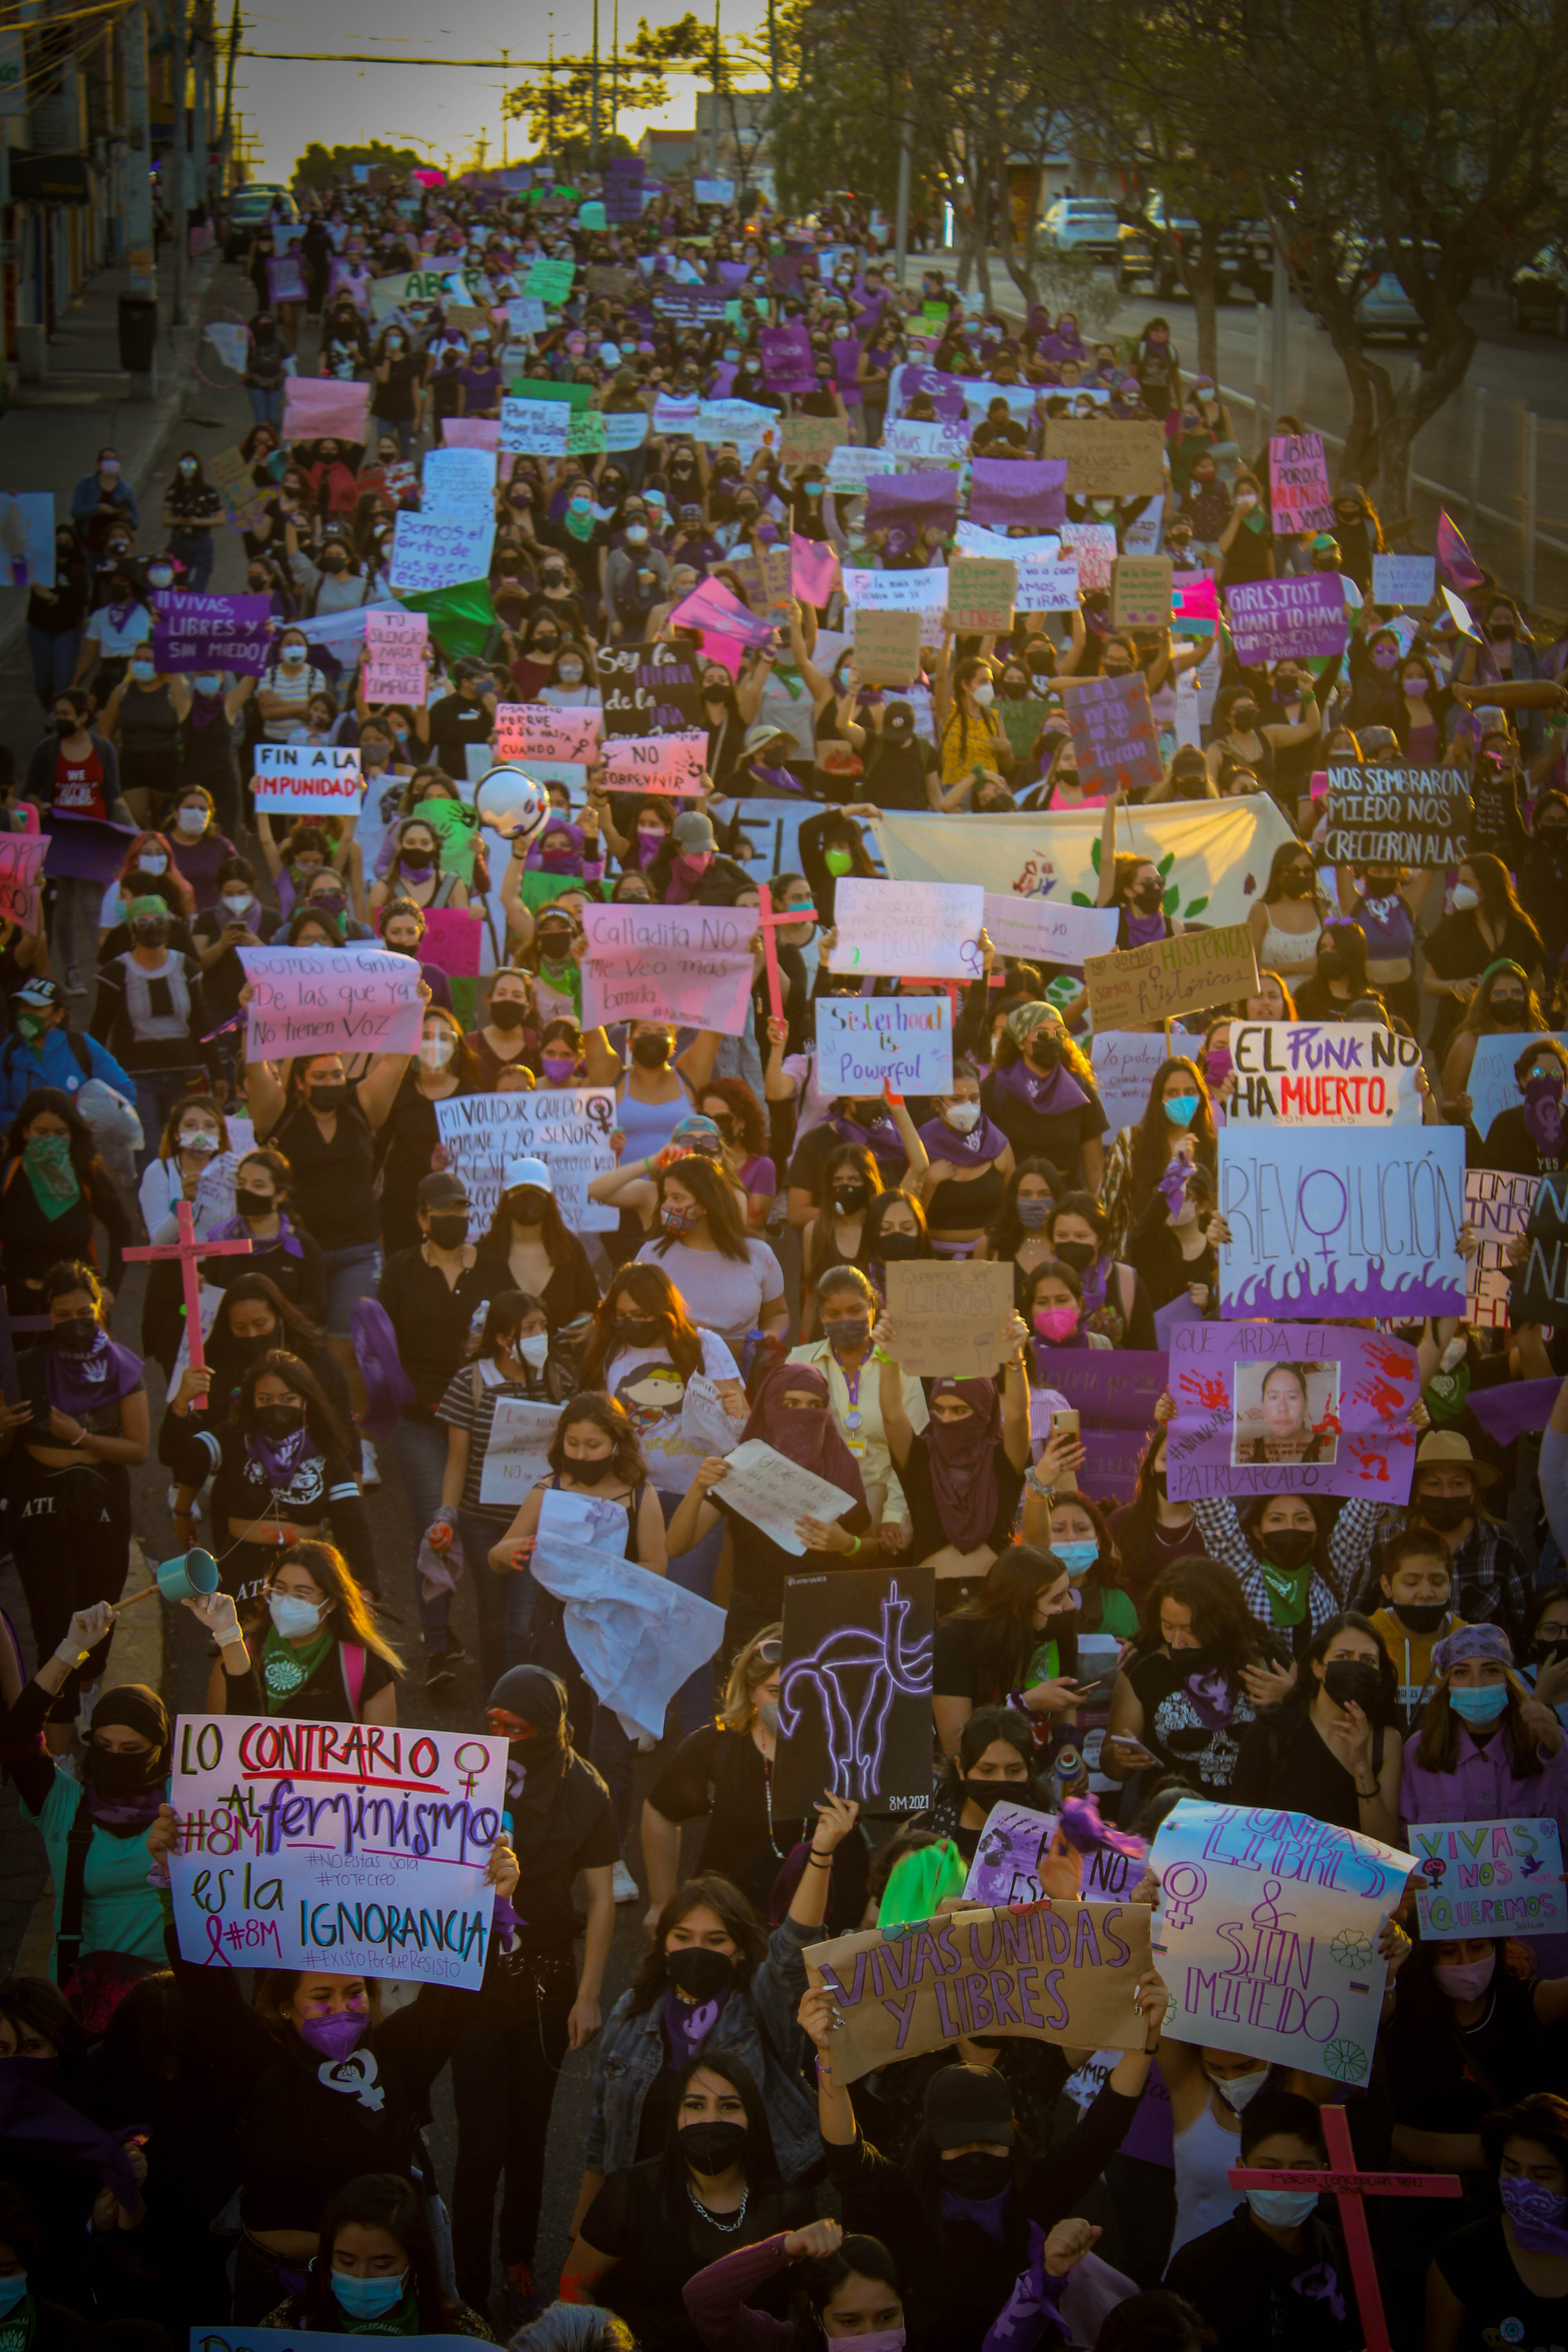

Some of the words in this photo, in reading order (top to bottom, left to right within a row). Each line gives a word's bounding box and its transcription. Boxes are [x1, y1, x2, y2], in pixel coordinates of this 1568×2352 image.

[1018, 582, 1057, 592] AMOS
[1229, 584, 1275, 612] GIRLS
[1277, 582, 1321, 607] JUST
[169, 617, 235, 637] LIBRES
[1233, 611, 1279, 633] WANT
[1285, 609, 1305, 628] TO
[169, 642, 196, 659] SIN
[597, 646, 641, 674] Soy
[652, 642, 677, 666] la
[605, 688, 633, 710] de
[501, 715, 551, 728] PORQUE
[261, 748, 298, 766] FIN
[312, 749, 327, 766] A
[333, 752, 357, 768] LA
[501, 744, 555, 755] CUANDO
[632, 746, 659, 764] NO
[257, 776, 356, 797] IMPUNIDAD
[1328, 766, 1362, 790] NOS
[1364, 767, 1471, 795] SEMBRARON
[1406, 797, 1452, 827] NOS
[1324, 829, 1423, 864] CRECIERON
[1424, 835, 1468, 864] ALAS
[592, 916, 690, 949] Calladita
[700, 917, 739, 951] NO
[332, 955, 352, 973] el
[1091, 960, 1107, 972] NO
[1114, 947, 1154, 969] SOMOS
[255, 982, 287, 1011] De
[298, 981, 328, 1007] las
[339, 984, 376, 1015] que
[603, 982, 656, 1010] bonita
[831, 1002, 942, 1031] Sisterhood
[879, 1032, 897, 1052] is
[1235, 1027, 1287, 1073] EL
[1372, 1031, 1421, 1068] NO
[840, 1052, 921, 1086] Powerful
[1103, 1042, 1118, 1065] Yo
[1121, 1044, 1168, 1074] protest
[1230, 1075, 1278, 1119] HA
[516, 1127, 534, 1150] YO
[1537, 1157, 1559, 1171] YES
[1176, 1327, 1216, 1354] QUE
[1224, 1327, 1291, 1356] ARDA
[1305, 1330, 1332, 1357] EL
[1179, 1464, 1319, 1497] PATRIARCADO
[181, 1723, 223, 1775] LO
[238, 1723, 439, 1779] CONTRARIO
[176, 1808, 264, 1857] #8M
[217, 1784, 263, 1828] AL
[258, 1778, 503, 1864] feminismo
[1416, 1824, 1538, 1859] VIVAS
[191, 1869, 234, 1914] es
[243, 1862, 284, 1911] la
[1457, 1860, 1513, 1890] NOS
[1430, 1893, 1558, 1931] QUEREMOS
[222, 1918, 283, 1959] #8M
[300, 1899, 488, 1967] IGNORANCIA
[817, 1924, 962, 2008] VIVAS
[969, 1907, 1131, 1970] UNIDAS
[882, 1990, 916, 2049] Y
[934, 1967, 1069, 2038] LIBRES
[1185, 1967, 1339, 2043] MIEDO
